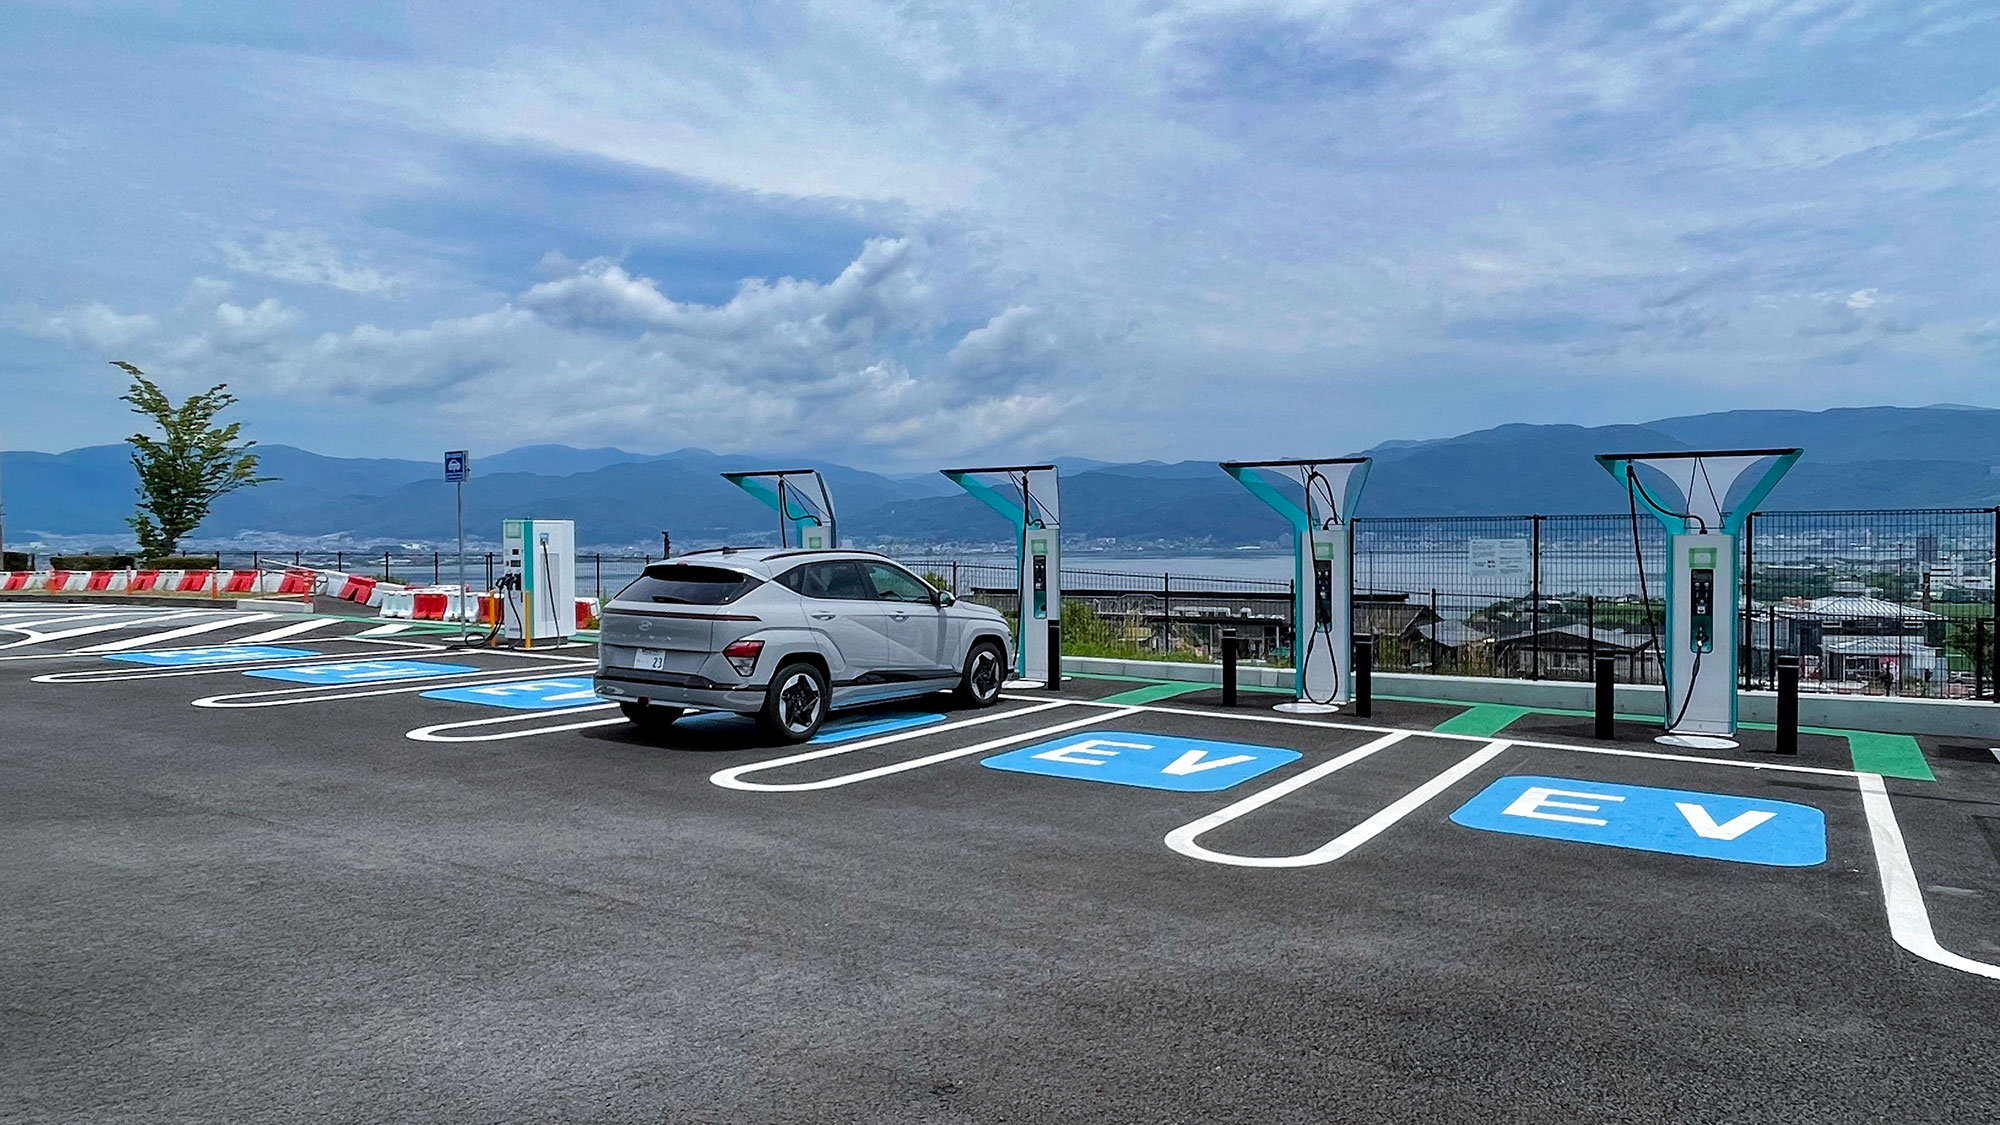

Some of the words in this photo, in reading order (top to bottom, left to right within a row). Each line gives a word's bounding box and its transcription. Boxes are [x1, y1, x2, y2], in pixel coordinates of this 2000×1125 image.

[286, 663, 440, 679] EV
[652, 657, 663, 669] 23
[1031, 739, 1257, 776] EV
[1501, 787, 1778, 841] EV
